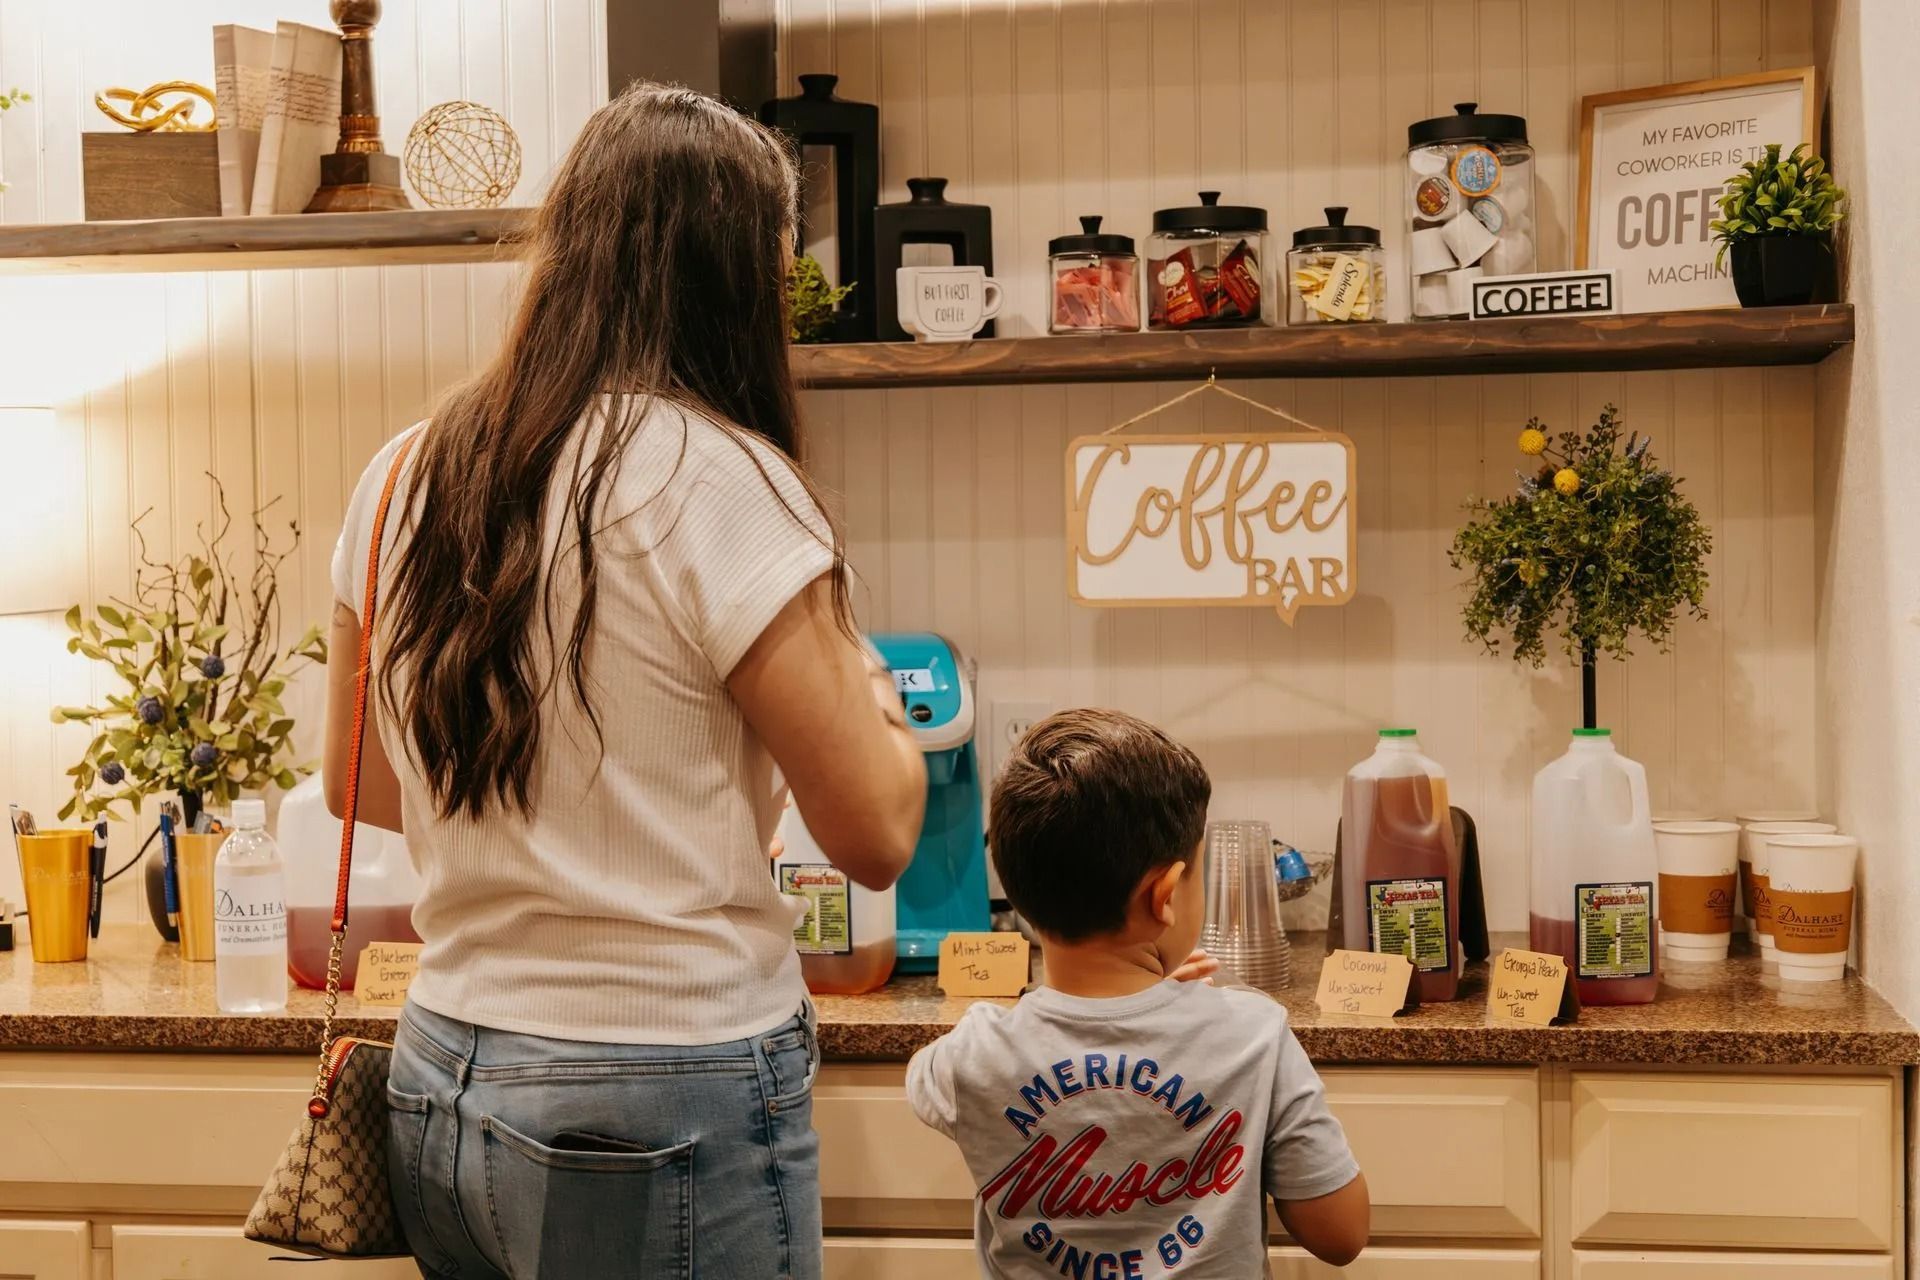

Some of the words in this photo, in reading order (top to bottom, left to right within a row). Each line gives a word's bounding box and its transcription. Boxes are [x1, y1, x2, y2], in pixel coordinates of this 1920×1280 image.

[1643, 129, 1667, 146] MY
[1673, 118, 1758, 143] FAVORITE
[1617, 151, 1722, 177] COWORKER
[1727, 149, 1743, 164] IS
[1748, 146, 1768, 161] TH
[1617, 186, 1736, 250] COFF
[924, 284, 942, 300] BUT
[1331, 262, 1359, 308] Splenda
[1482, 283, 1602, 315] COFFEE
[1078, 441, 1348, 571] Coffee
[1248, 556, 1348, 599] BAR
[1387, 890, 1418, 901] TEXAS
[1419, 889, 1439, 900] TEA
[1594, 895, 1626, 906] TEXAS
[1627, 894, 1646, 905] TEA
[1777, 904, 1843, 924] DALHART
[1783, 925, 1815, 934] FUNERAL
[952, 941, 981, 957] Mint
[985, 941, 1017, 955] Sweet
[960, 963, 991, 981] Tea
[1342, 954, 1389, 974] Coconut
[1538, 956, 1561, 978] Peach
[365, 986, 395, 1001] Sweet
[1339, 997, 1361, 1013] Tea
[1506, 1002, 1526, 1018] Tea
[1003, 1053, 1215, 1140] AMERICAN
[319, 1121, 342, 1135] MK
[319, 1148, 342, 1162] MK
[977, 1107, 1245, 1221] Muscle
[319, 1175, 342, 1189] MK
[319, 1202, 342, 1216] MK
[1022, 1221, 1144, 1280] SINCE
[1157, 1214, 1205, 1269] 66
